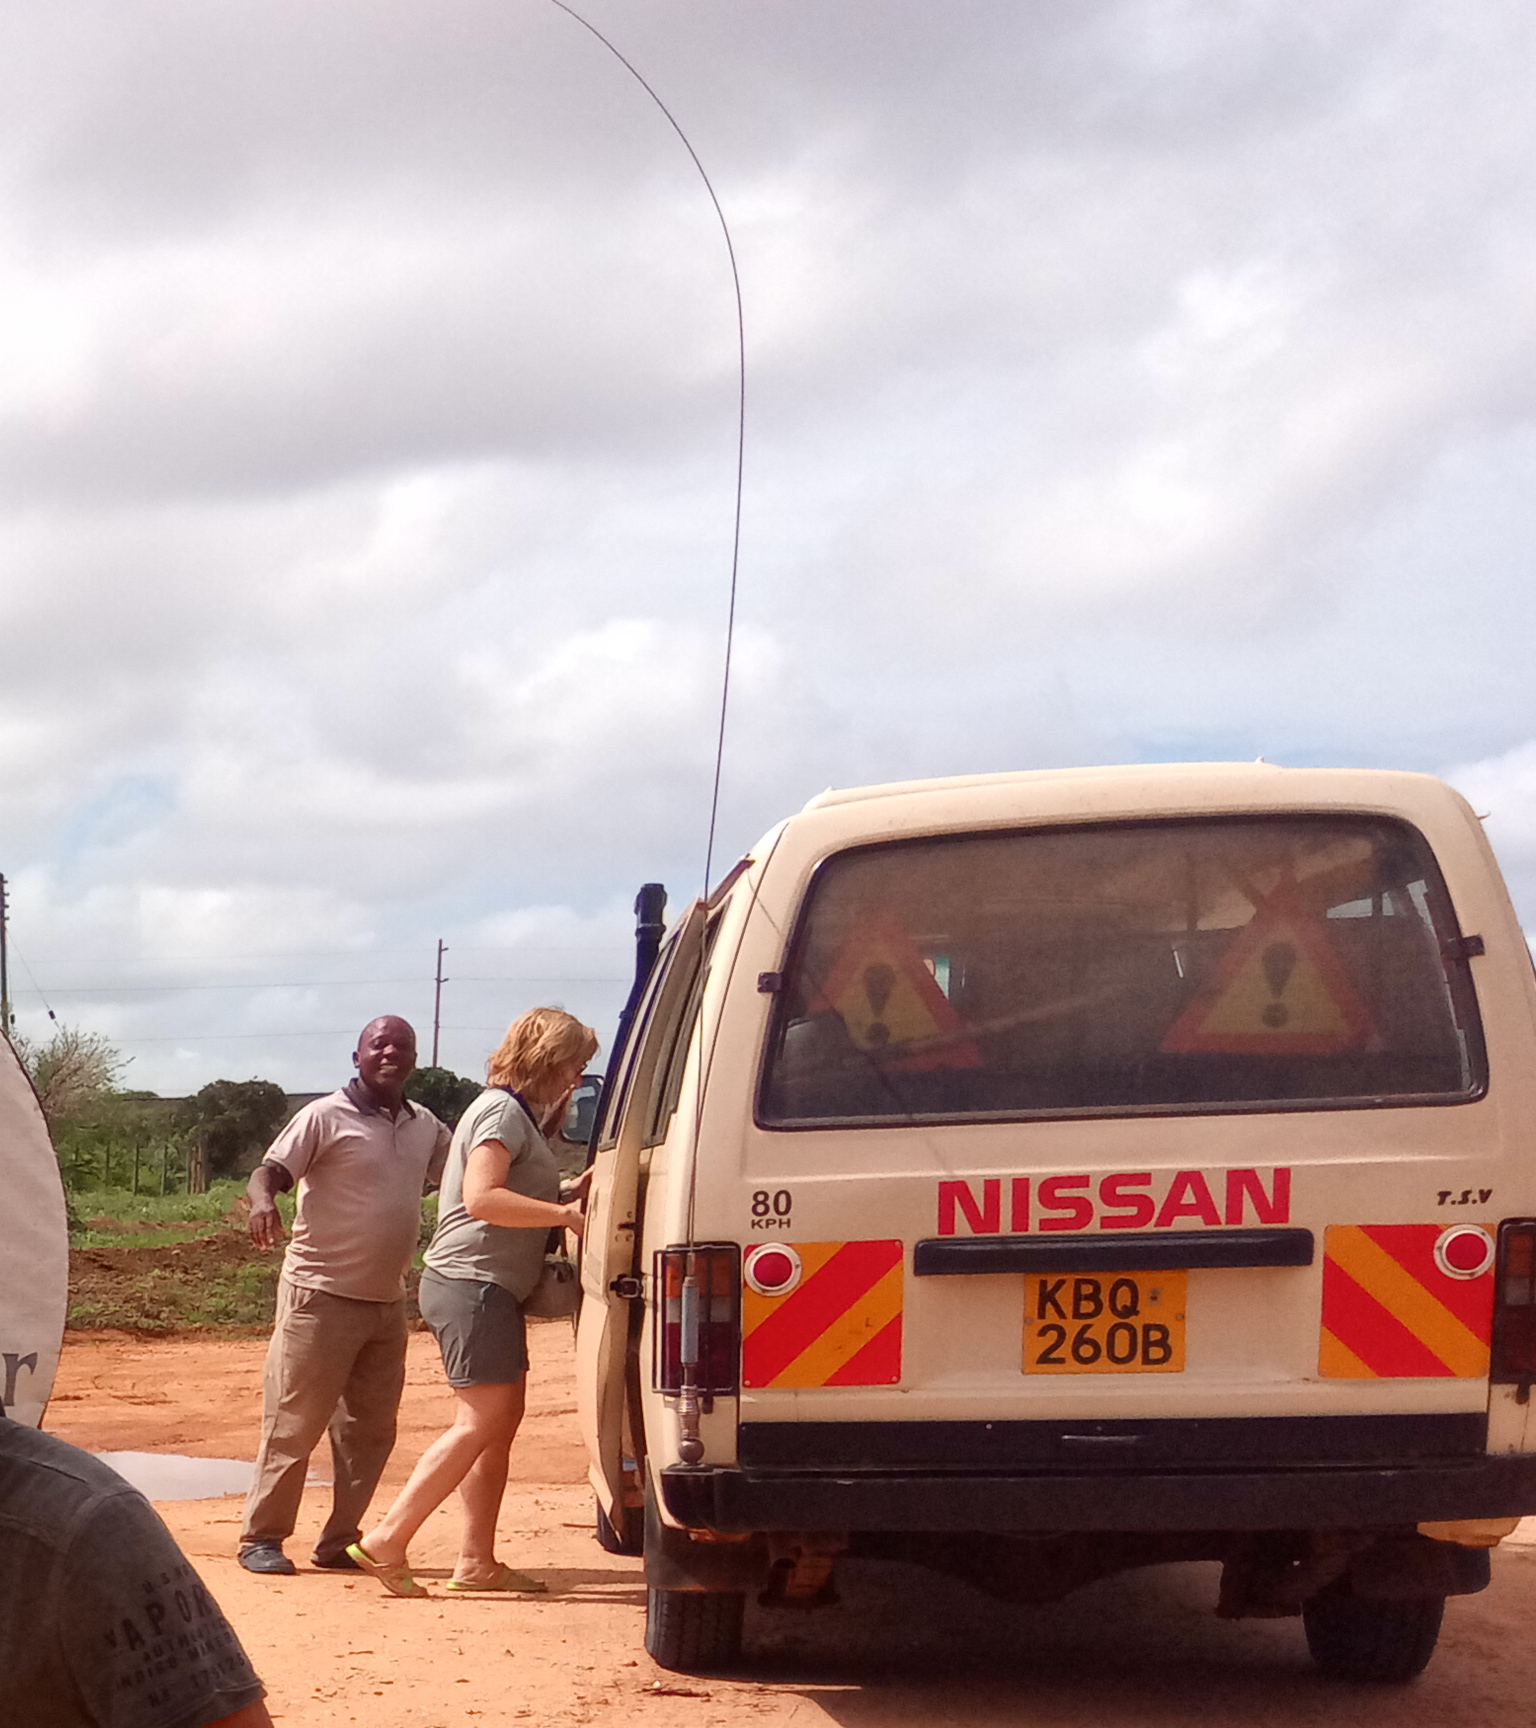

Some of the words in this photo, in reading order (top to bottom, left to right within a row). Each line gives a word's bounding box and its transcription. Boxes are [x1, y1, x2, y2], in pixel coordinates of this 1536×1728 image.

[751, 1189, 792, 1217] 80
[938, 1168, 1291, 1235] NISSAN
[750, 1218, 792, 1229] KPH
[1037, 1277, 1140, 1320] KBQ
[1035, 1322, 1173, 1366] 260B
